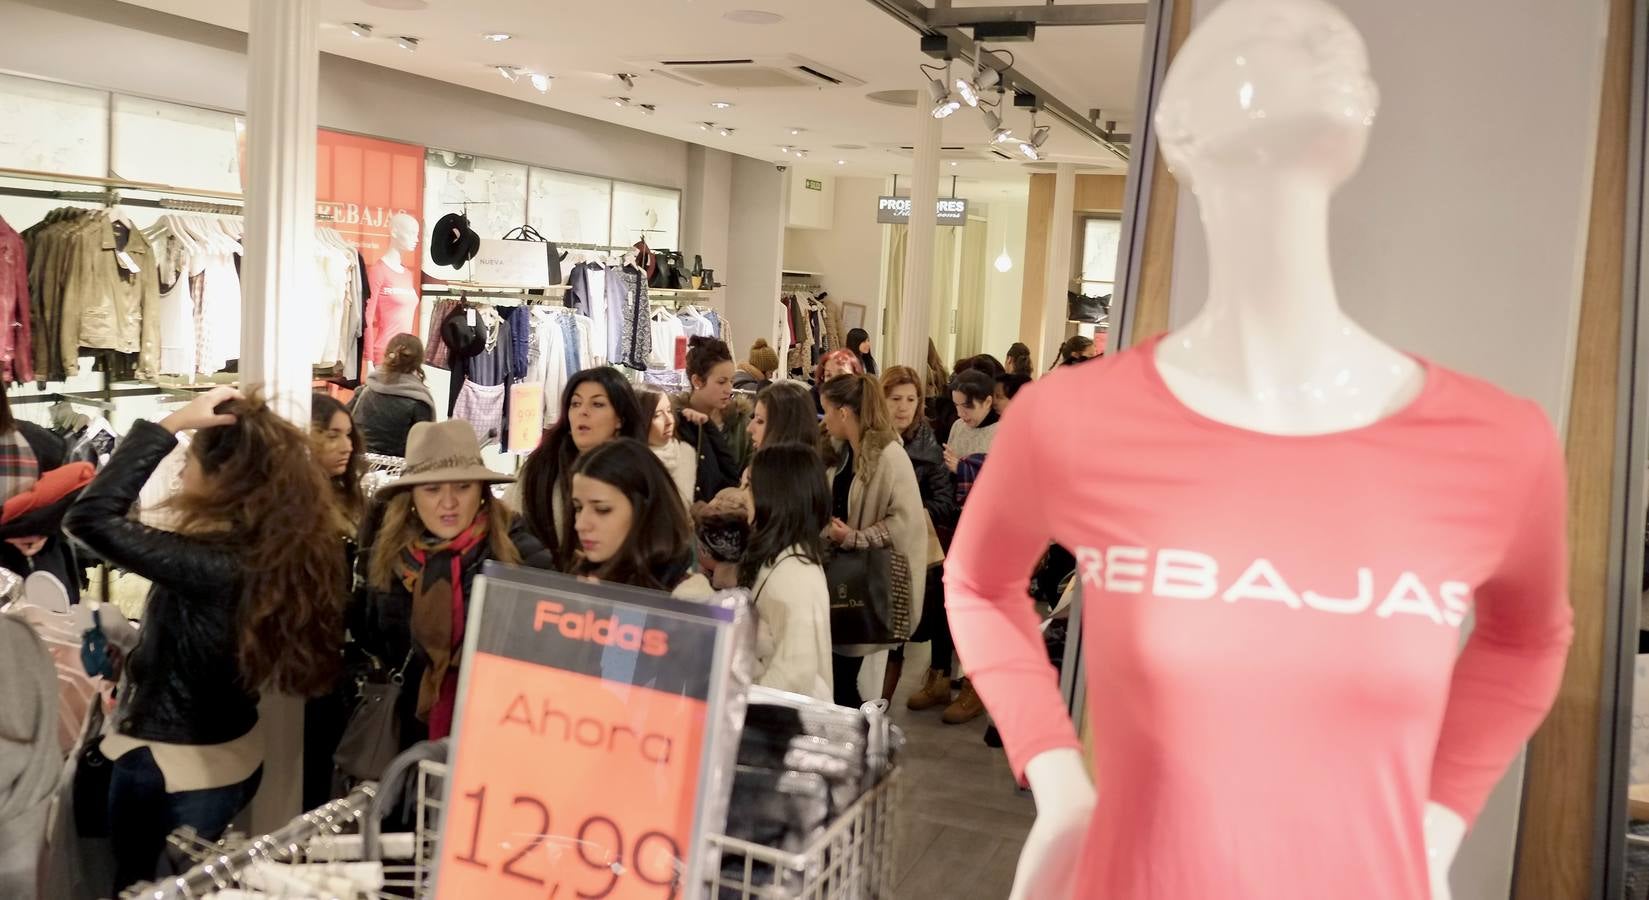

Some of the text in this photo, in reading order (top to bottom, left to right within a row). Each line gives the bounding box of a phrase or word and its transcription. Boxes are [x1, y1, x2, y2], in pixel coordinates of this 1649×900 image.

[317, 202, 407, 229] REBAJA
[879, 199, 965, 213] PROBRES
[1076, 545, 1472, 627] REBAJAS
[533, 600, 669, 656] Faldas
[500, 694, 673, 763] Ahora
